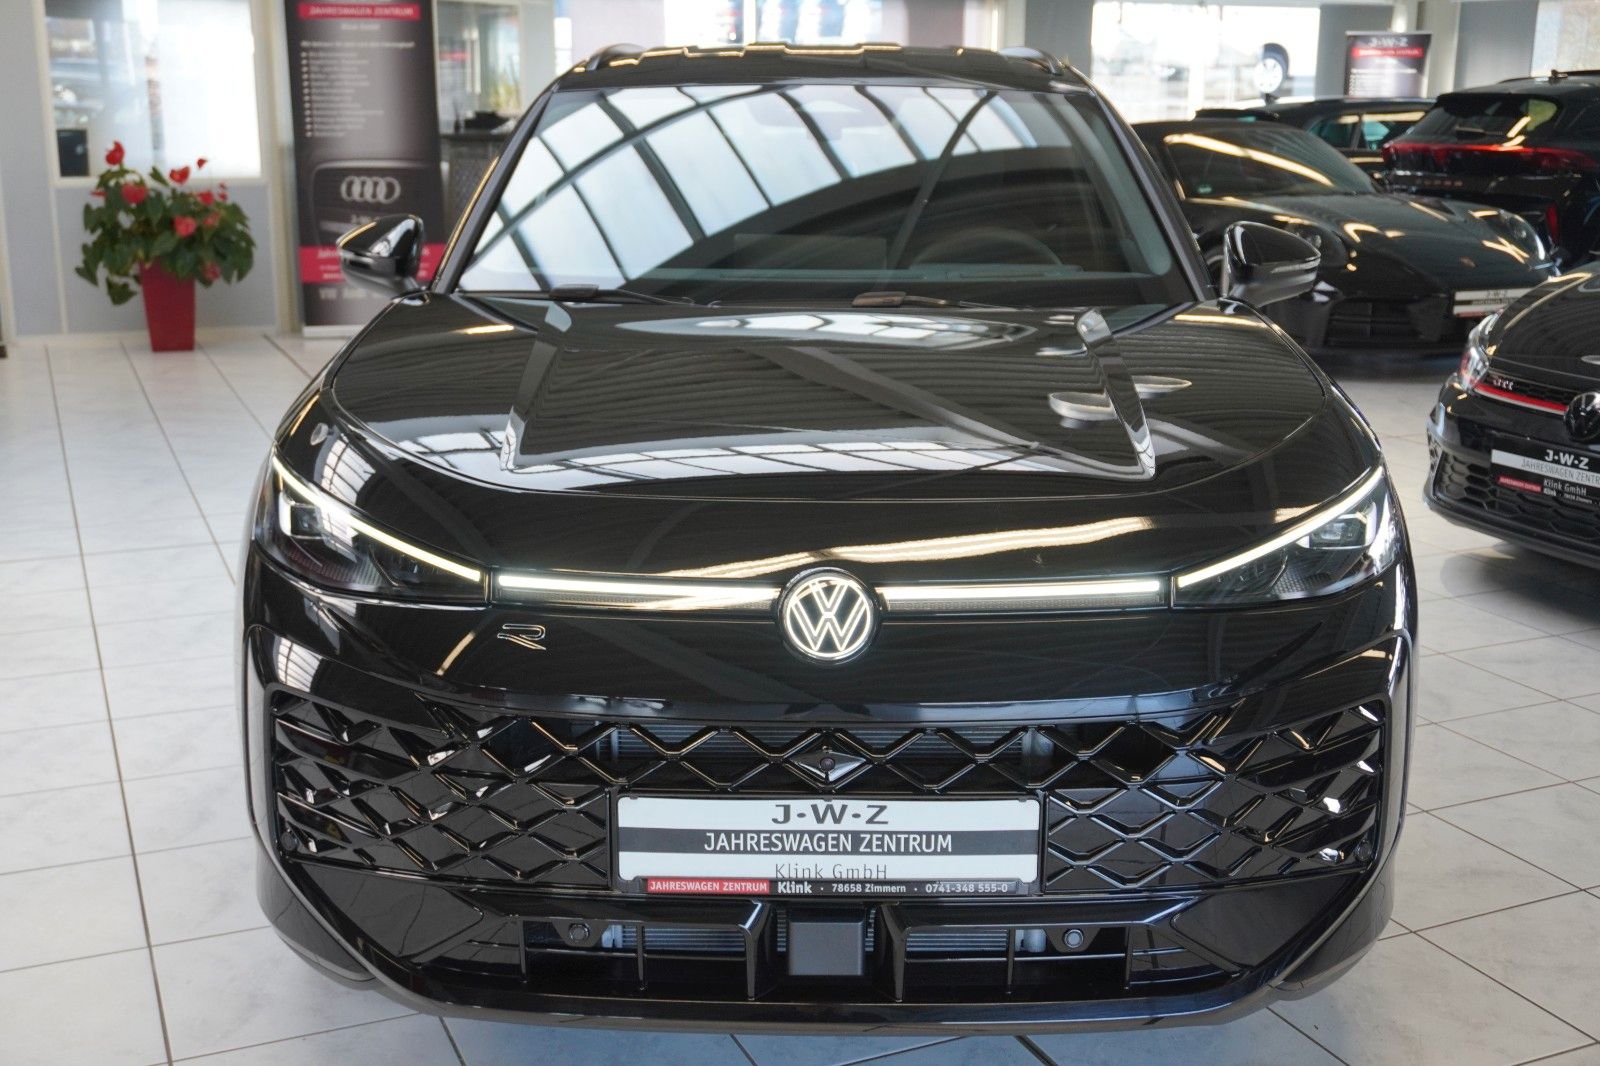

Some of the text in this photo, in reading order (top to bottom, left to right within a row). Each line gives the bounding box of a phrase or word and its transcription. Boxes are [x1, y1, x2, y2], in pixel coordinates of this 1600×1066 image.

[1521, 459, 1600, 486] JAHRESWAGEN ZENTR
[787, 578, 870, 658] VW
[497, 623, 547, 650] R
[704, 832, 952, 853] JAHRESWAGEN ZENTRUM
[775, 862, 888, 880] Klink GmbH
[650, 881, 1008, 894] JAHRESWAGEN ZENTRUM Klink 78658 Zimmern 0741-348 555-0
